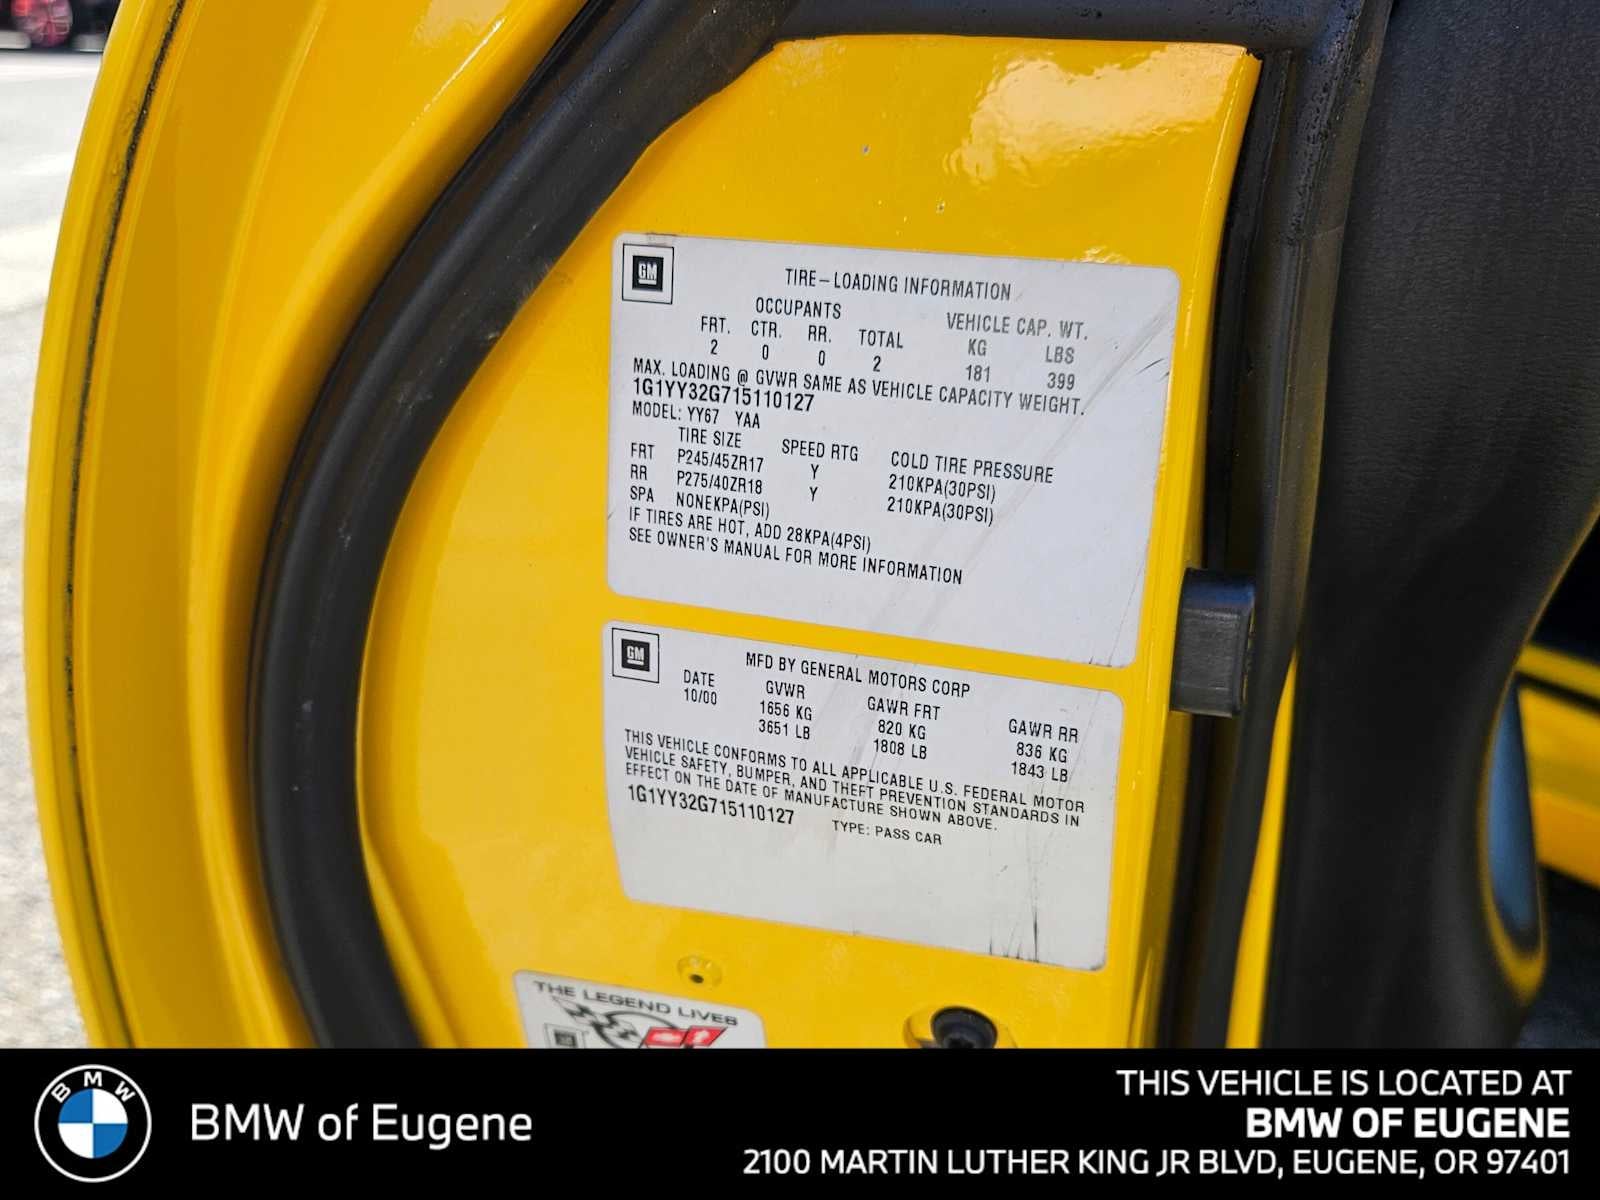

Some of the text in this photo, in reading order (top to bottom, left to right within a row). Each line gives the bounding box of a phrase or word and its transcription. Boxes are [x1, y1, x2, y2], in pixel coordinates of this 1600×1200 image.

[638, 262, 657, 280] GM
[905, 277, 1011, 300] INFORMATION
[756, 297, 841, 319] OCCUPANTS
[701, 316, 903, 348] FRT. CTR. RR. TOTAL
[947, 313, 1088, 340] VEHICLE CAP. WT.
[711, 340, 881, 371] 2 0 0 2
[968, 339, 1075, 364] KG LBS
[634, 358, 1085, 415] MAX. LOADING @ GVWR SAME AS VEHICLE CAPACITY WEIGHT.
[966, 365, 1075, 390] 181 399
[634, 378, 814, 411] 1G1YY32G715110127
[632, 401, 760, 429] MODEL: YY67 YAA
[679, 427, 742, 448] TIRE SIZE
[782, 439, 858, 462] SPEED RTG
[631, 443, 996, 504] FRT P245/45ZR17 Y 210KPA(30PSI)
[892, 451, 1054, 484] COLD TIRE PRESSURE
[630, 486, 769, 520] SPA NONEKPA(PSI)
[631, 464, 994, 527] RR P275/40ZR18 Y 210KPA(30PSI)
[629, 507, 640, 521] IF
[647, 509, 683, 527] TIRES
[688, 514, 712, 531] ARE
[755, 524, 781, 540] ADD
[787, 527, 871, 554] 28KPA(4PSI)
[629, 528, 962, 584] SEE OWNER'S MANUAL FOR MORE INFORMATION
[627, 646, 644, 661] GM
[684, 670, 715, 687] DATE
[746, 652, 970, 697] MFD BY GENERAL MOTORS CORP
[684, 688, 717, 705] 10/00
[766, 681, 805, 699] GVWR
[760, 701, 812, 721] 1656 KG
[867, 696, 940, 720] GAWR FRT
[759, 720, 810, 739] 3651 LB
[878, 720, 926, 740] 820 KG
[1009, 719, 1078, 743] GAWR RR
[874, 739, 927, 759] 1808 LB
[1016, 742, 1067, 763] 836 KG
[625, 729, 1084, 813] THIS VEHICLE CONFORMS TO ALL APPLICABLE U.S. FEDERAL MOTOR
[1011, 761, 1068, 782] 1843 LB
[625, 746, 1079, 826] VEHICLE SAFETY, BUMPER, AND THEFT PREVENTION STANDARDS IN
[626, 763, 997, 831] EFFECT ON THE DATE OF MANUFACTURE SHOWN ABOVE.
[628, 785, 794, 824] 1G1YY32G715110127
[832, 820, 942, 844] TYPE: PASS CAR
[534, 981, 576, 997] THE
[583, 990, 671, 1014] LEGEND
